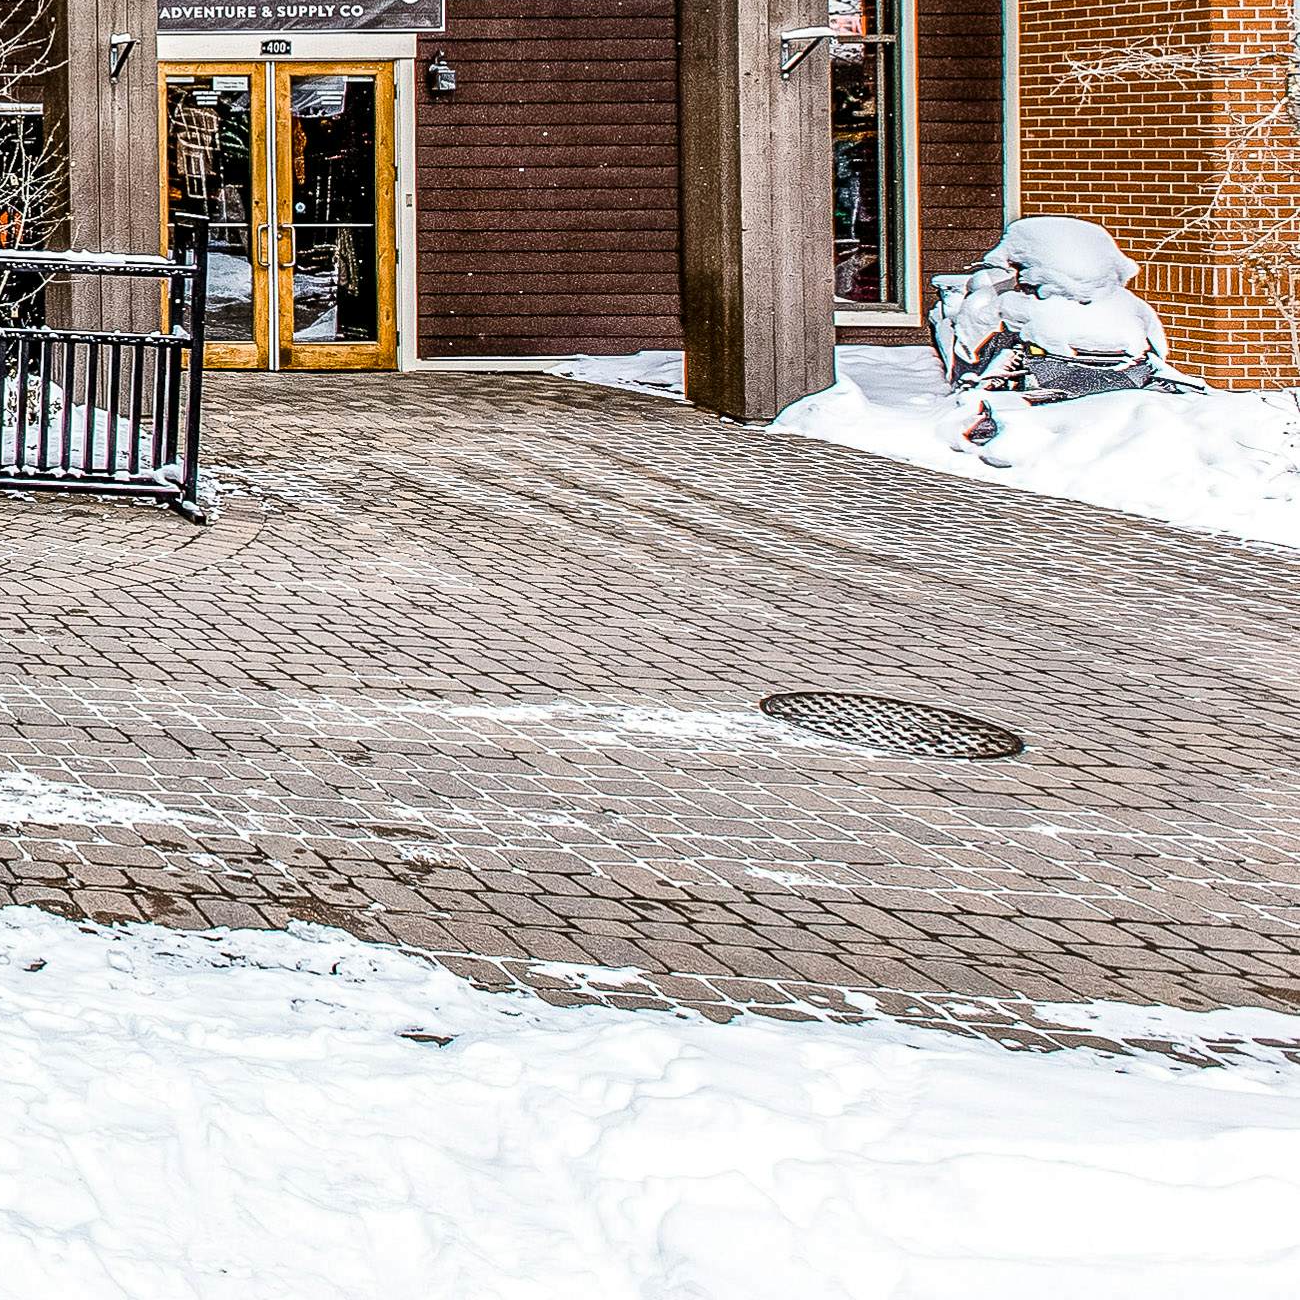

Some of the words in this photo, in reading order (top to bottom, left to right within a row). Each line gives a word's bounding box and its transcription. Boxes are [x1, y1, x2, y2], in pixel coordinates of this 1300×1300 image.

[158, 4, 257, 20] ADVENTURE
[261, 4, 273, 18] &
[276, 4, 336, 19] SUPPLY
[340, 4, 364, 18] CO
[266, 41, 287, 54] 400
